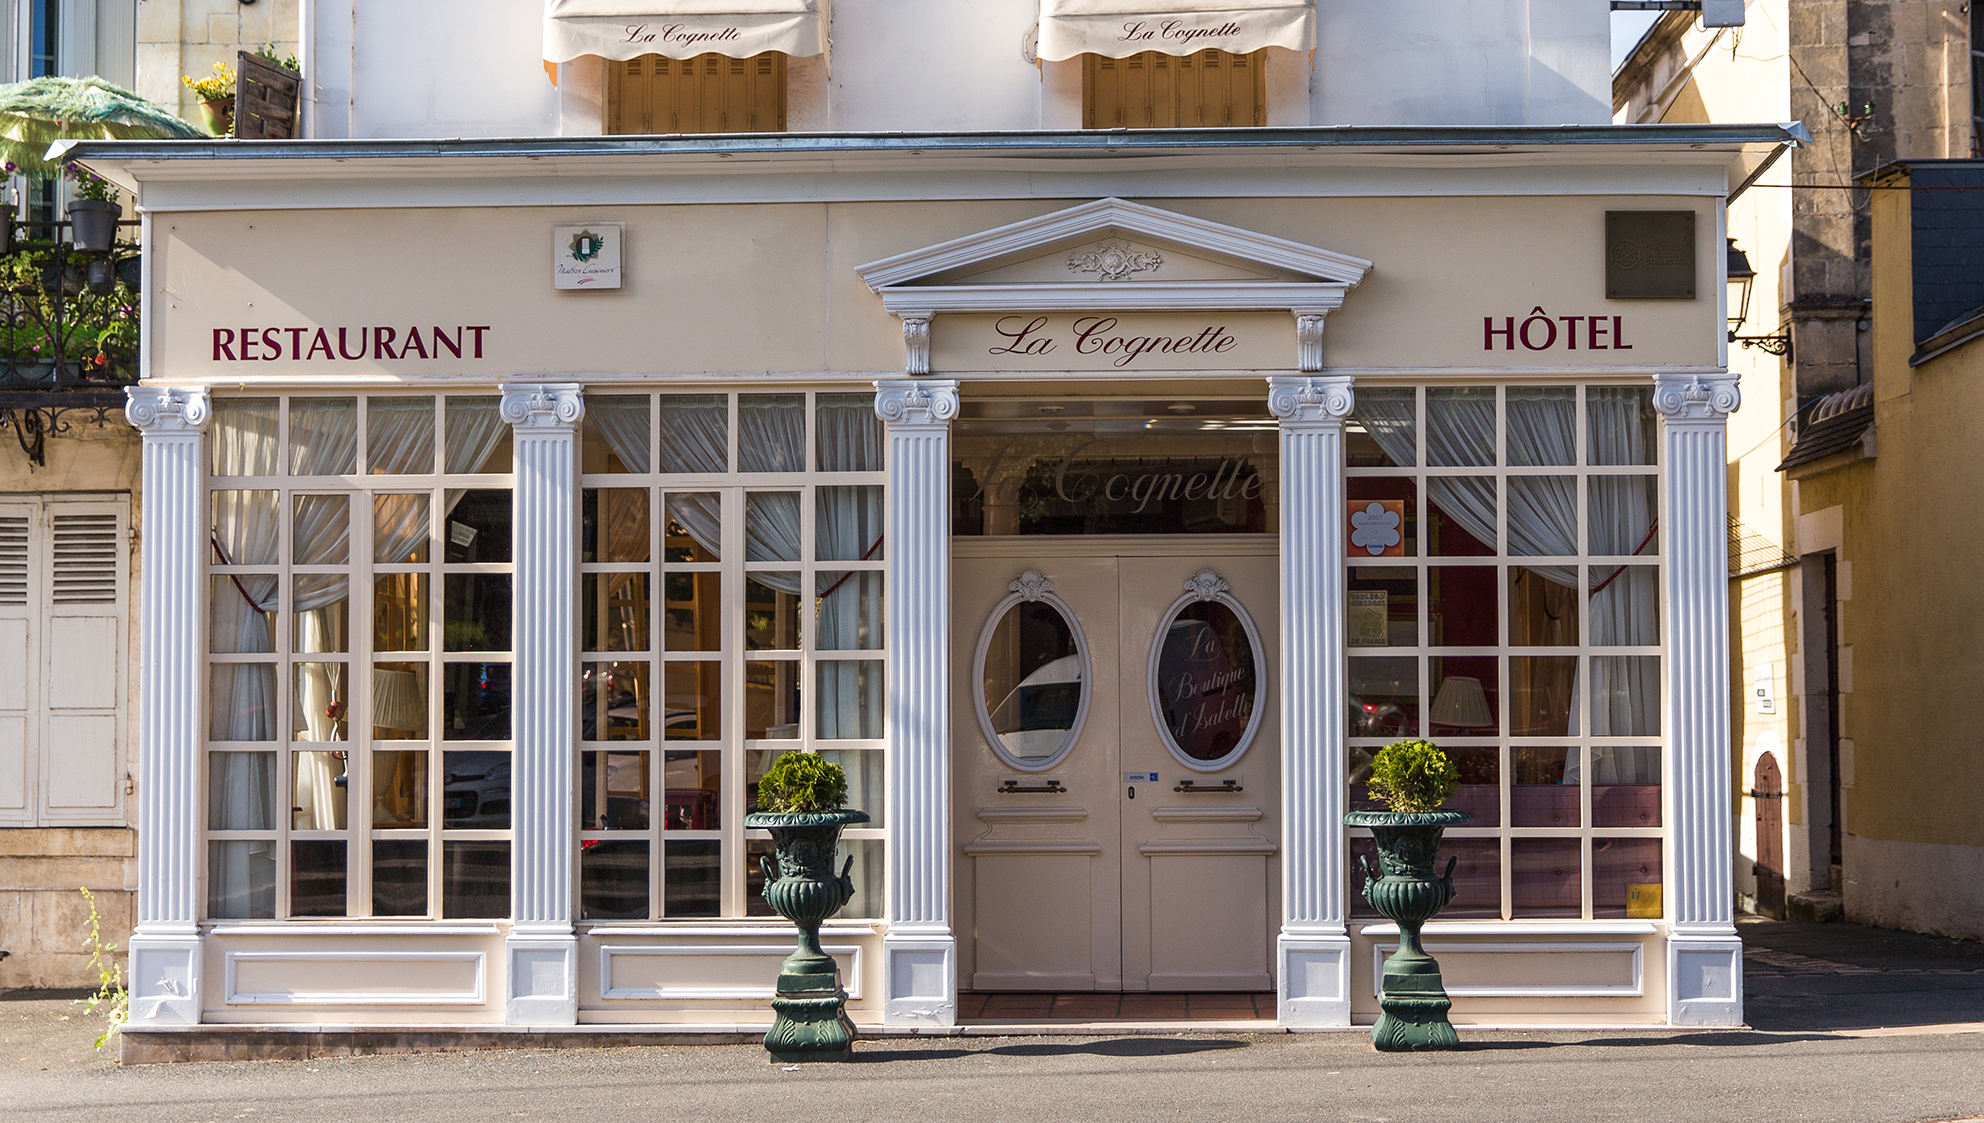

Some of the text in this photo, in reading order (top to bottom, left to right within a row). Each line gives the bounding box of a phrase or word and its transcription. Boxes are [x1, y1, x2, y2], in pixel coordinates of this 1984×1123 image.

[619, 24, 743, 48] La Cognette
[1117, 20, 1242, 45] La Cognette
[212, 325, 491, 361] RESTAURANT
[988, 315, 1238, 368] La Cognette
[1483, 305, 1633, 351] HÔTEL
[963, 438, 1267, 514] La Cognette
[1183, 626, 1221, 662] La
[1362, 637, 1386, 645] FRANCE
[1168, 667, 1245, 704] Boutique
[1175, 692, 1252, 738] d'Isabelle
